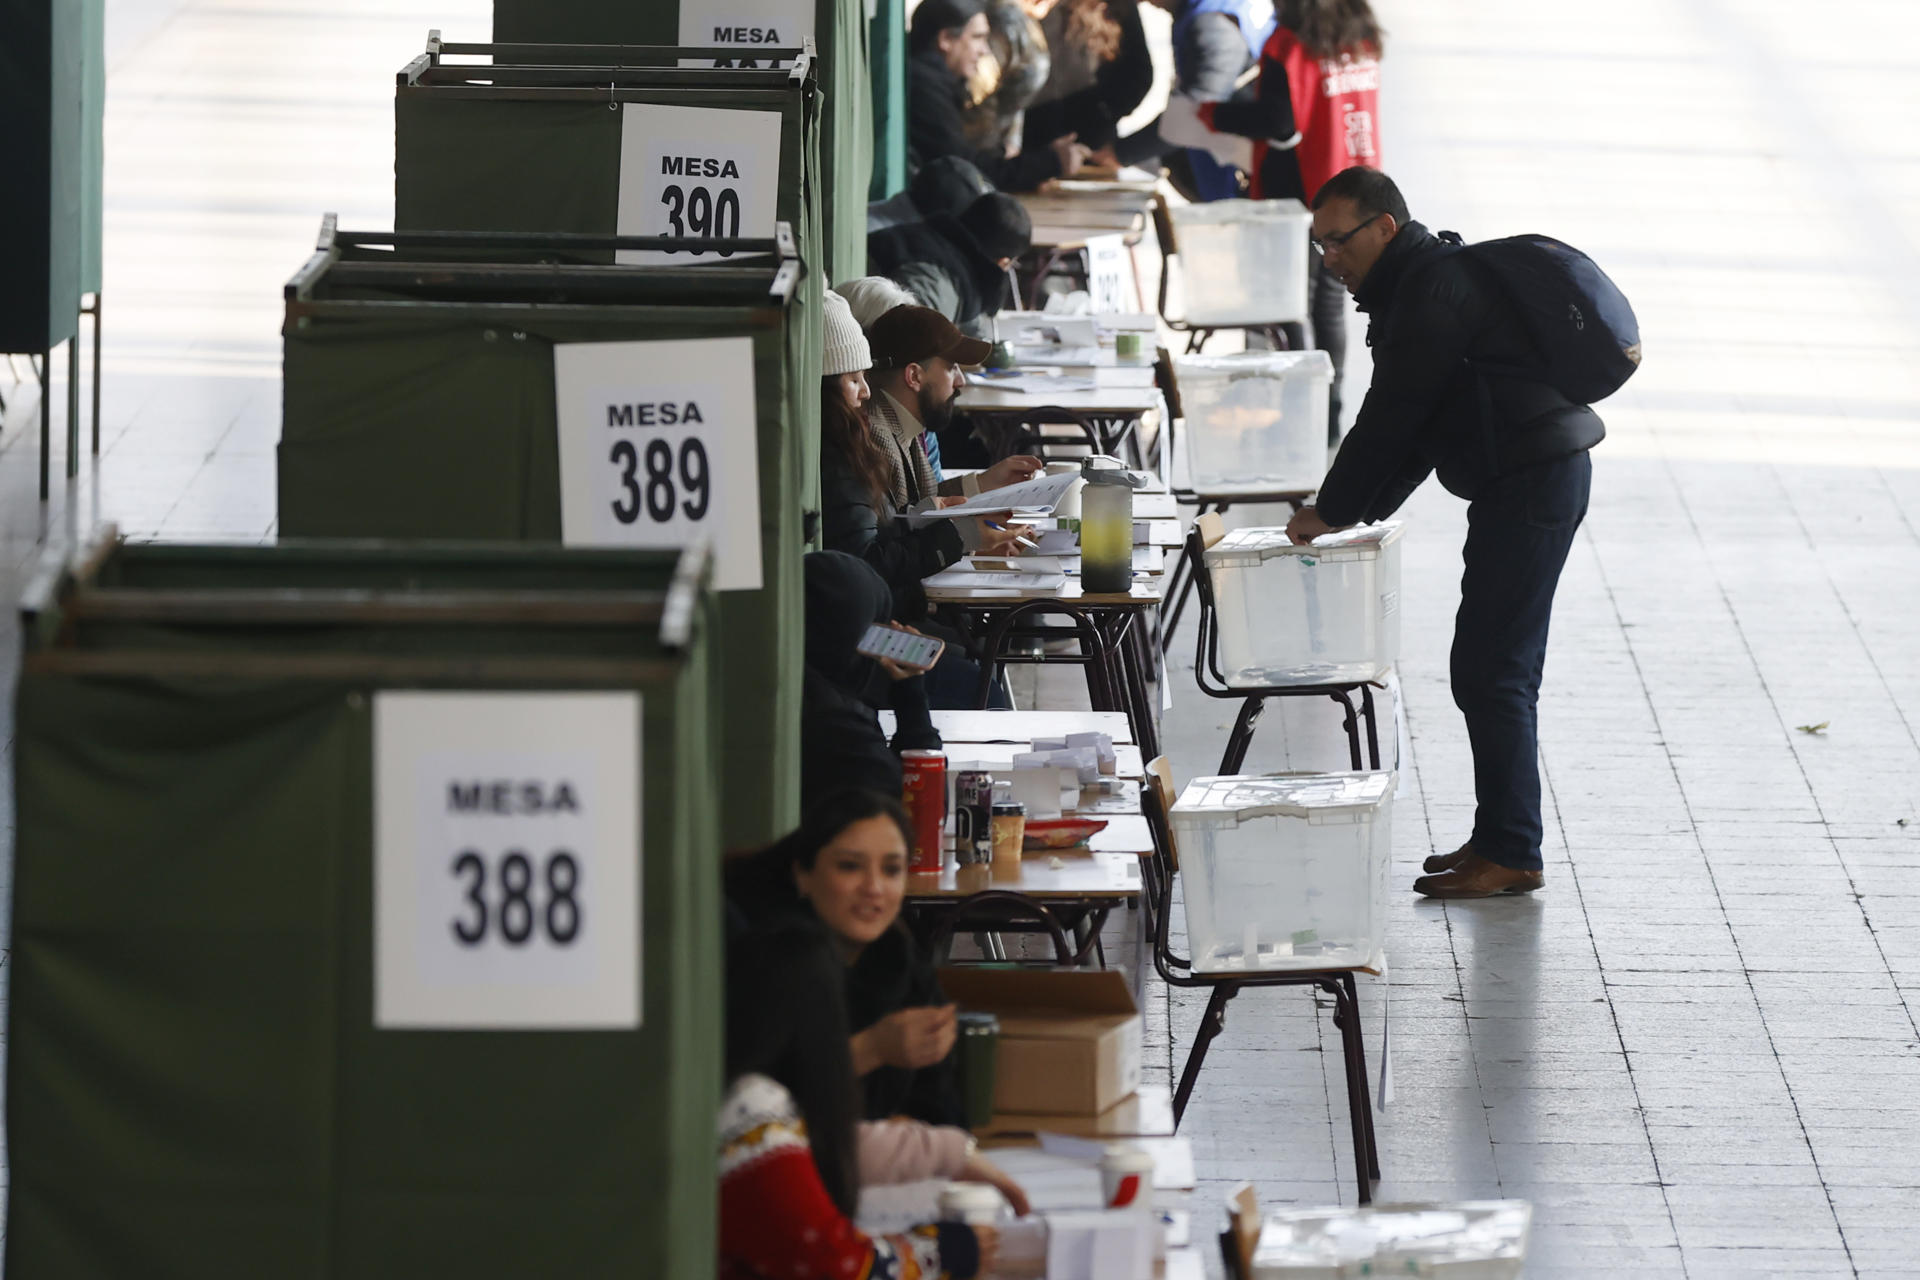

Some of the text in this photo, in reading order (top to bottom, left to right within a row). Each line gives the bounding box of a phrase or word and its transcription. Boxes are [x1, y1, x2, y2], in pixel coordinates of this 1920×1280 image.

[714, 27, 780, 43] MESA
[661, 156, 739, 178] MESA
[659, 184, 740, 258] 390
[606, 402, 703, 427] MESA
[609, 437, 709, 525] 389
[448, 779, 580, 815] MESA
[452, 849, 582, 947] 388
